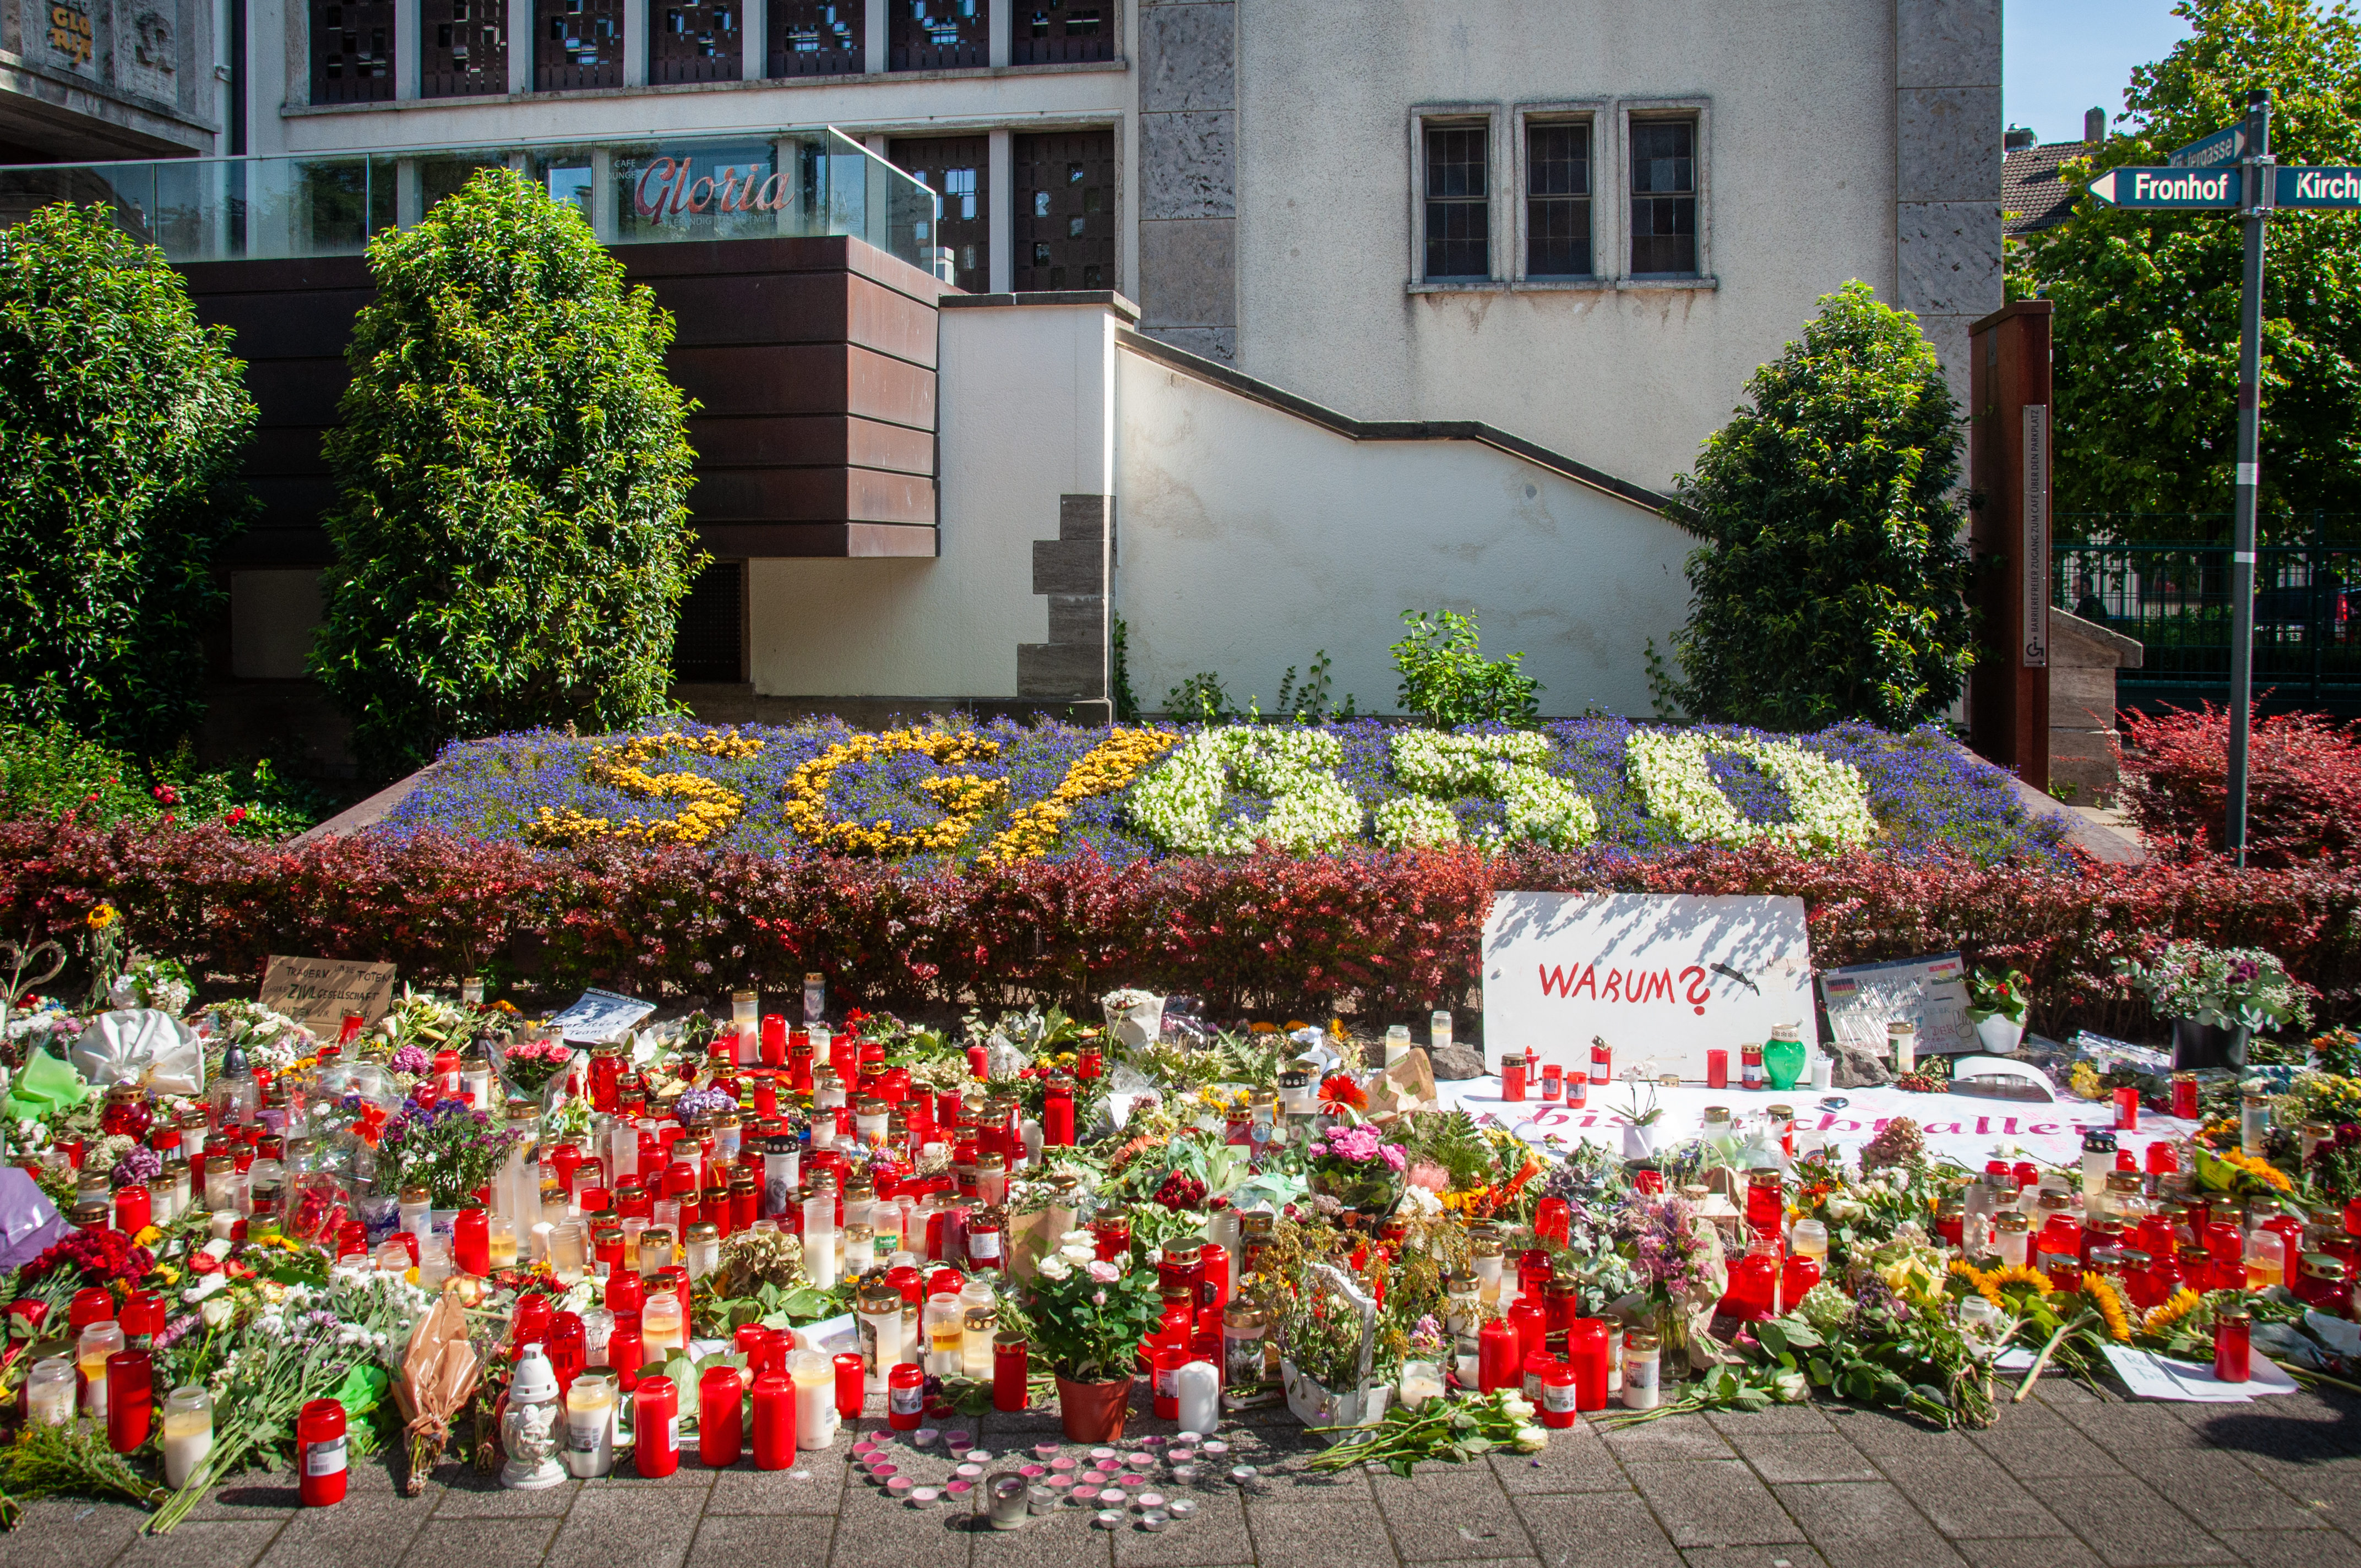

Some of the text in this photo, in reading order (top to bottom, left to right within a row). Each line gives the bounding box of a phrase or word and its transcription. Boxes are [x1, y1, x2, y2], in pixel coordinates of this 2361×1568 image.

[51, 28, 93, 63] RIA
[614, 159, 636, 168] CAFE
[2170, 138, 2233, 167] tergasse
[635, 156, 796, 226] Gloria
[2135, 172, 2228, 200] Fronhof
[2296, 172, 2361, 204] Kirch
[2031, 410, 2039, 451] PARKPLATZ
[2031, 453, 2039, 470] DEN
[2029, 471, 2039, 492] ÜBER
[2031, 514, 2039, 533] ZUM
[2031, 533, 2039, 569] ZUGANG
[2031, 571, 2039, 632] BARRIEREFREIER
[286, 966, 330, 978] TRAUERN
[357, 970, 392, 983] TOTEN
[1539, 962, 1711, 1016] WARUM?
[561, 1020, 623, 1028] Herzstück
[1929, 1024, 1955, 1036] DER
[1532, 1106, 1664, 1128] bis
